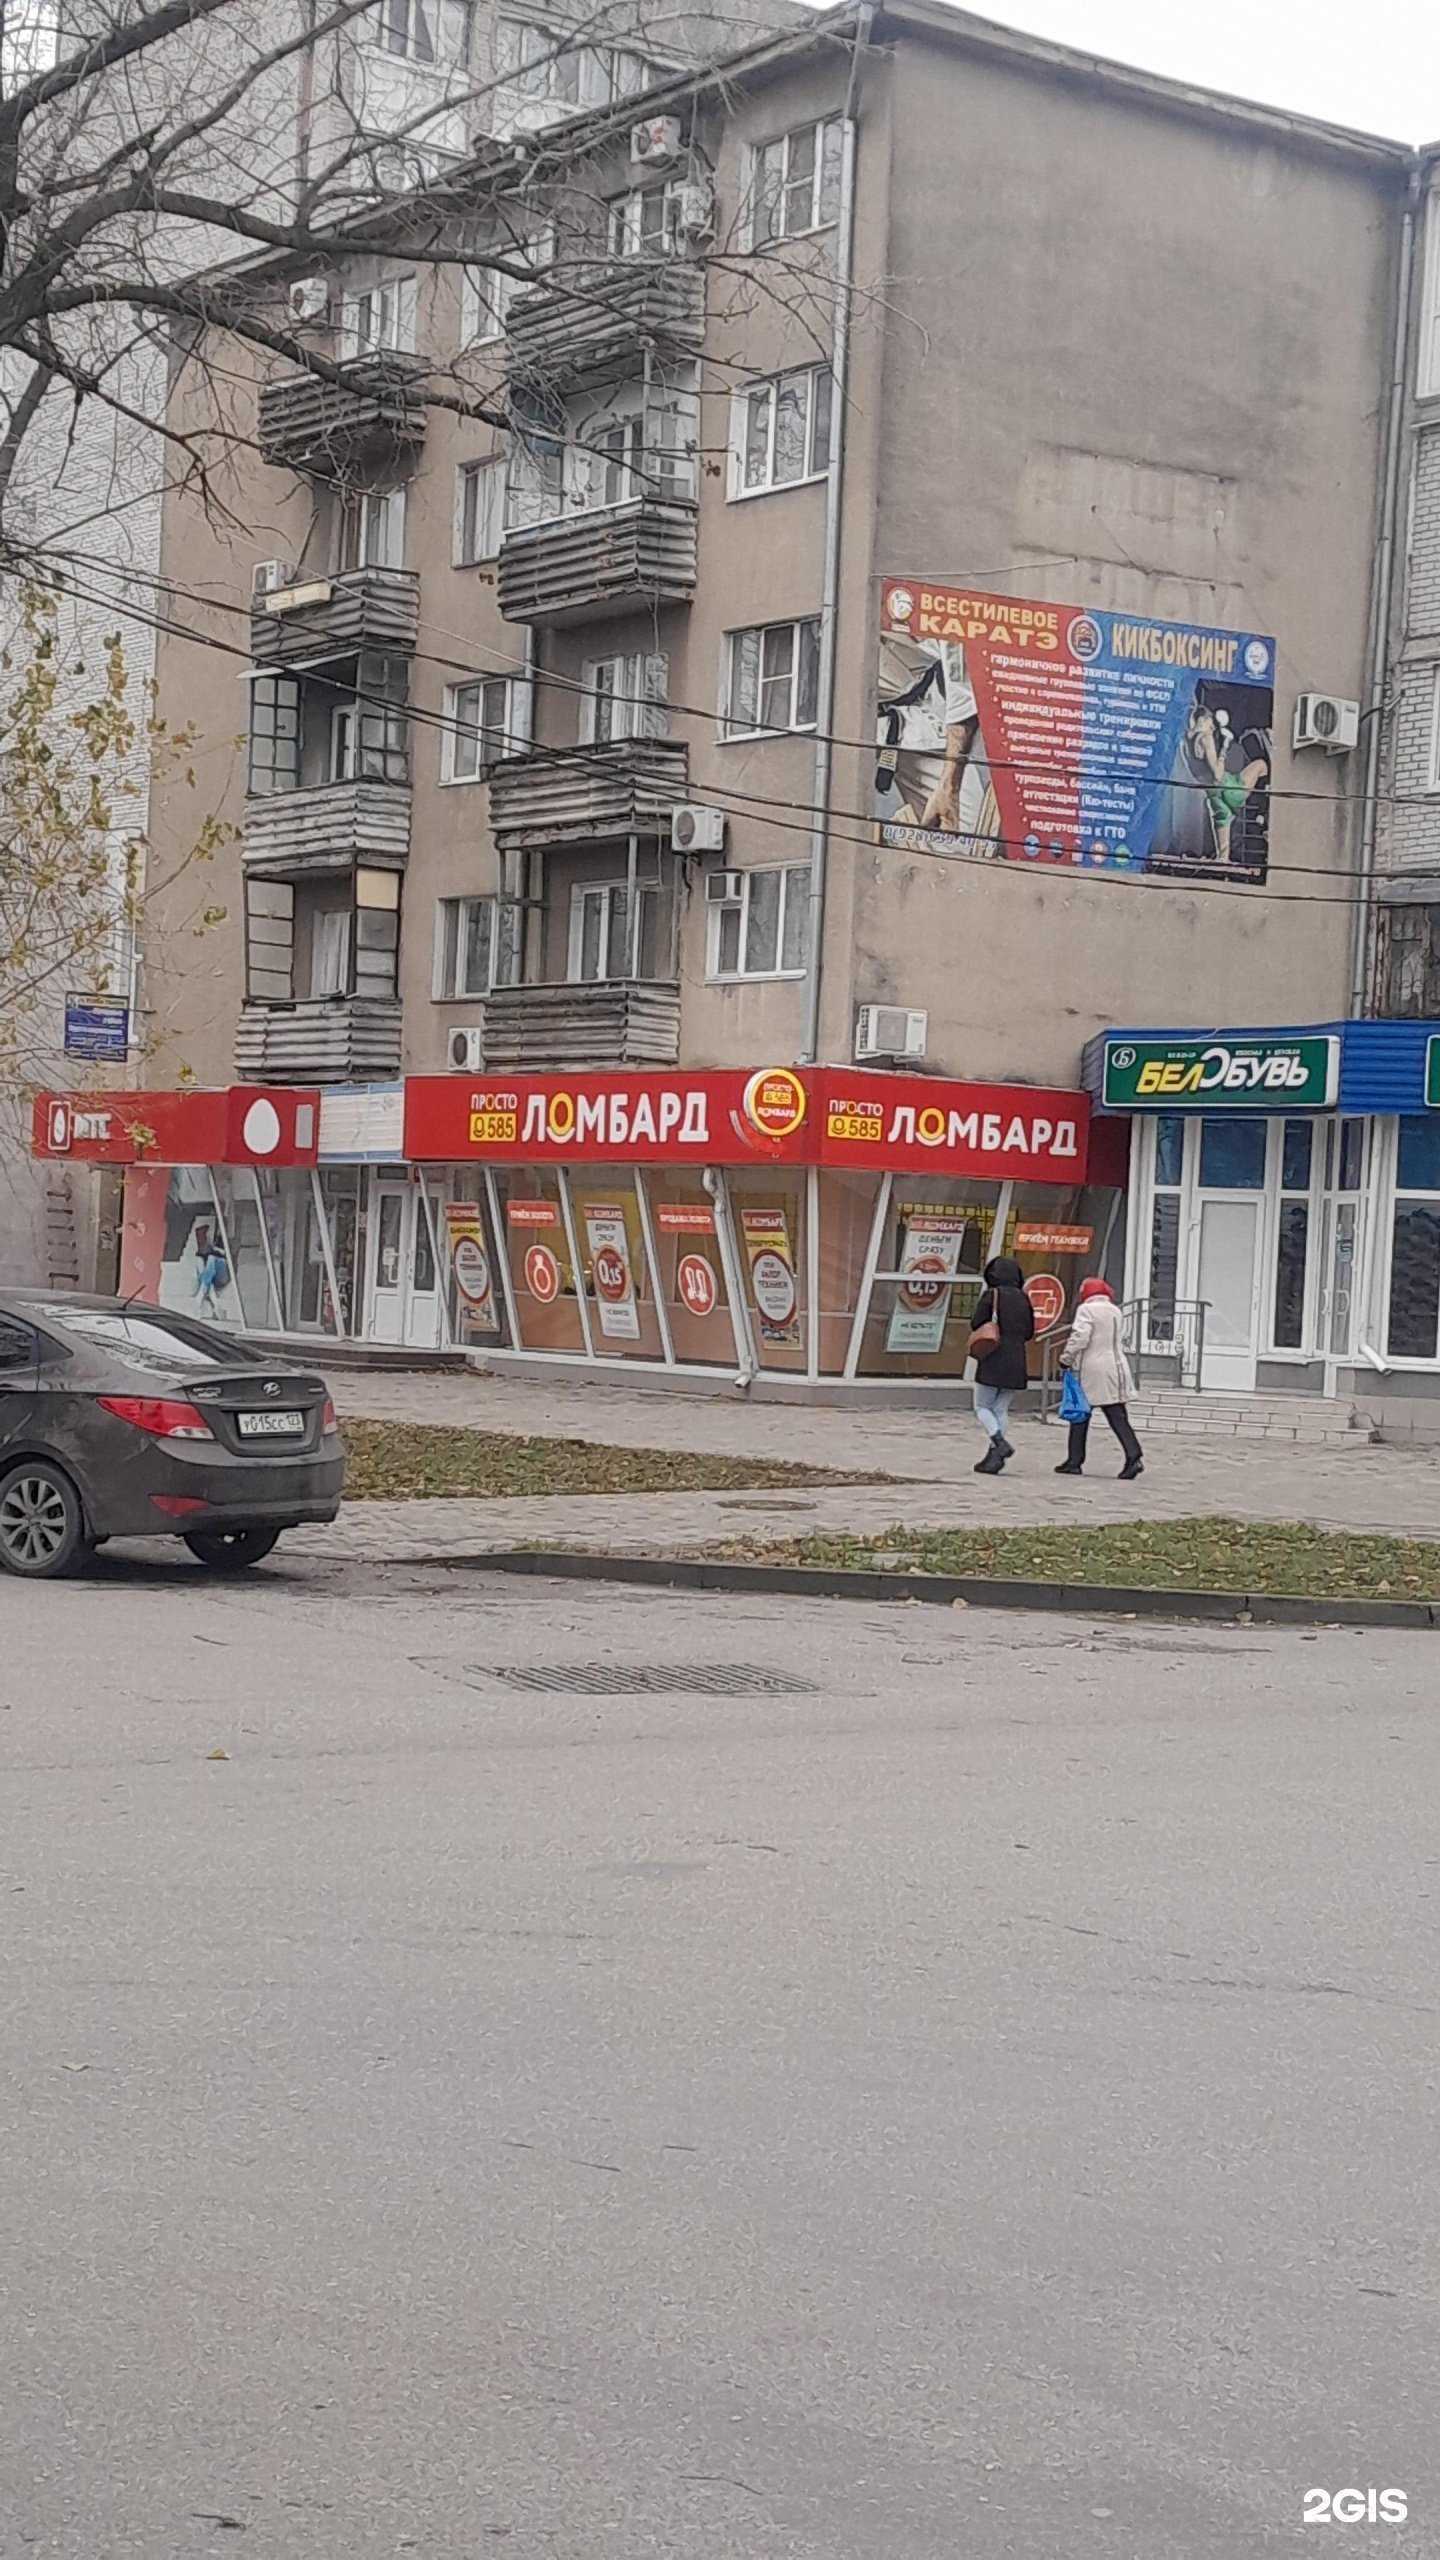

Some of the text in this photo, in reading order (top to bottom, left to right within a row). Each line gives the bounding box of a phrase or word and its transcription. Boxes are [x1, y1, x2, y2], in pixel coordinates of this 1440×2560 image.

[920, 593, 1059, 630] ВСЕСТИЛЕВОЕ
[919, 614, 1060, 650] КАРАТЭ
[1112, 623, 1239, 673] КИКБОКСИНГ
[1100, 712, 1162, 730] тренировки
[1104, 825, 1127, 840] ГТО
[471, 1093, 519, 1112] ПРОСТО
[521, 1092, 710, 1144] ЛОМБАРД
[829, 1099, 884, 1117] ПРОСТО
[887, 1106, 1078, 1157] ЛОМБАРД
